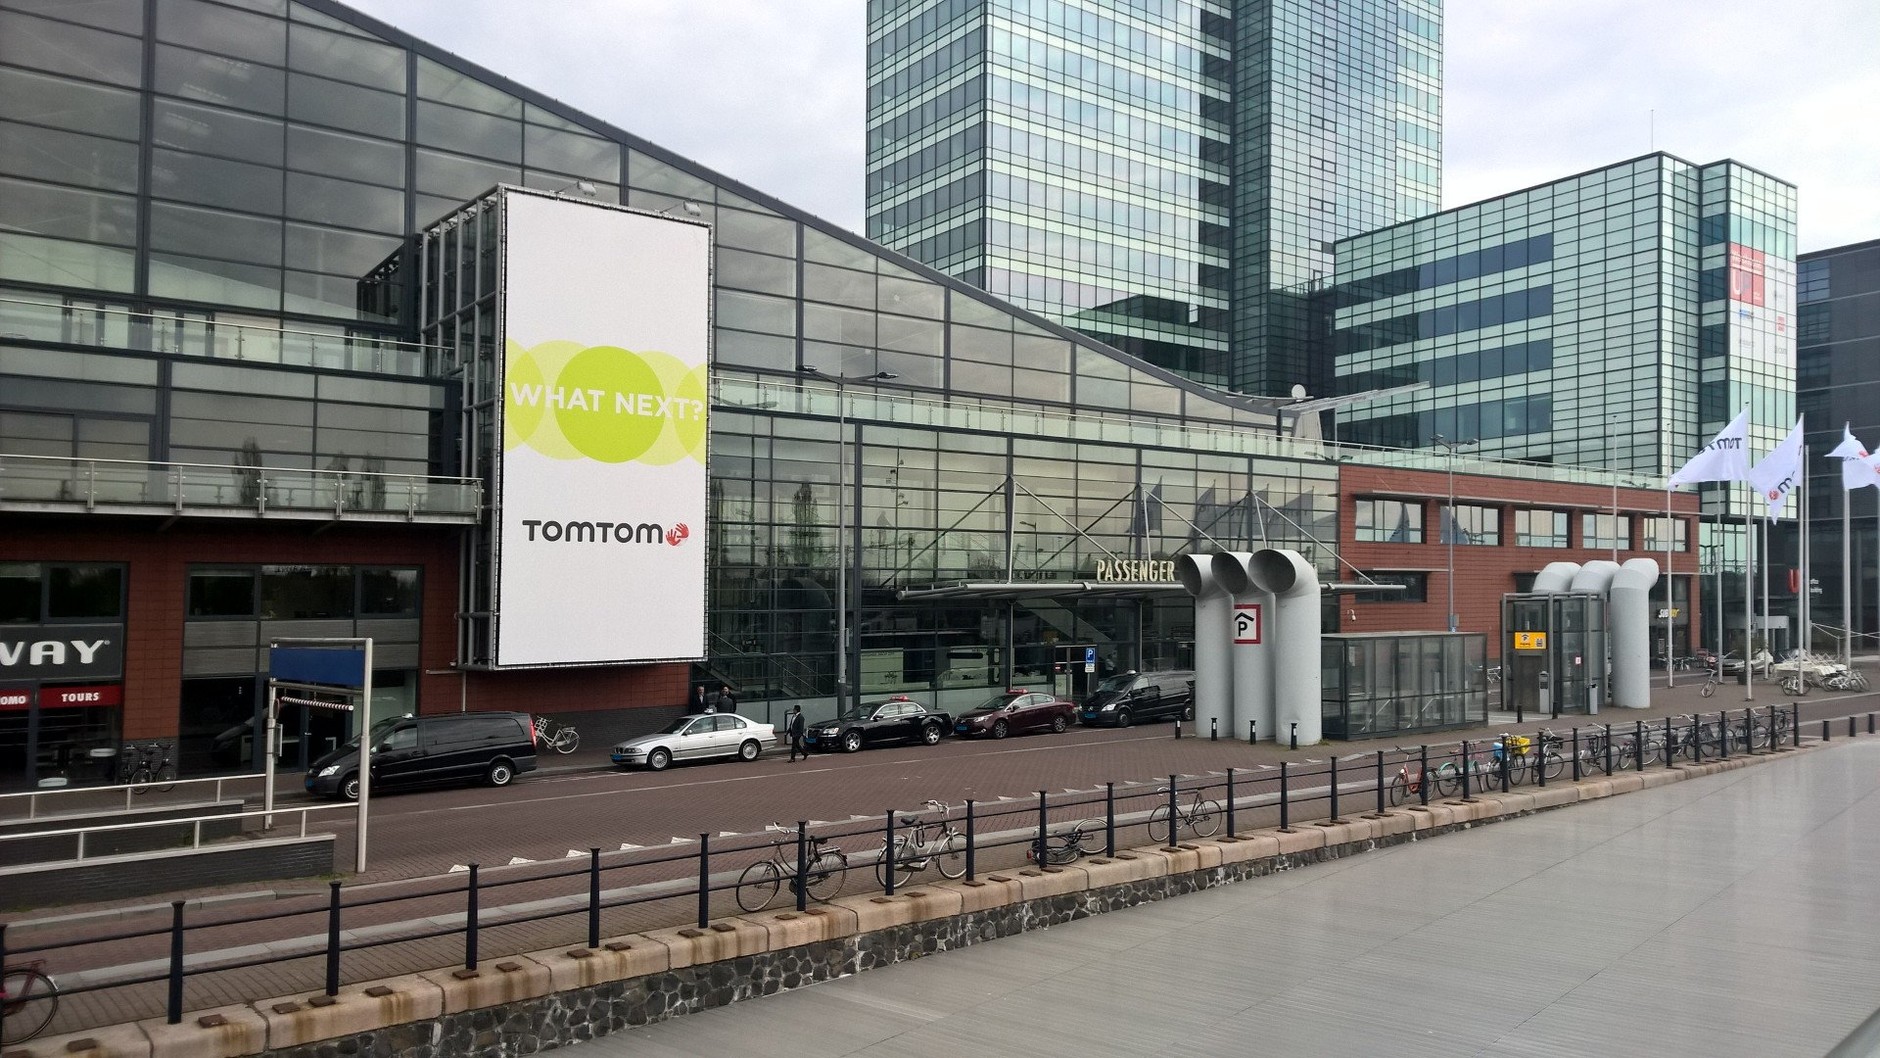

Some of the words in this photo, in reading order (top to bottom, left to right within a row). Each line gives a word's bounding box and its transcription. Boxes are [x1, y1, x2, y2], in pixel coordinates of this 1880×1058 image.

[510, 382, 605, 412] WHAT
[615, 392, 705, 421] NEXT?
[522, 519, 663, 544] TOMTOM
[1096, 559, 1175, 582] PASSENGER
[1238, 621, 1248, 637] P
[0, 695, 27, 705] OMO
[61, 692, 100, 702] TOURS
